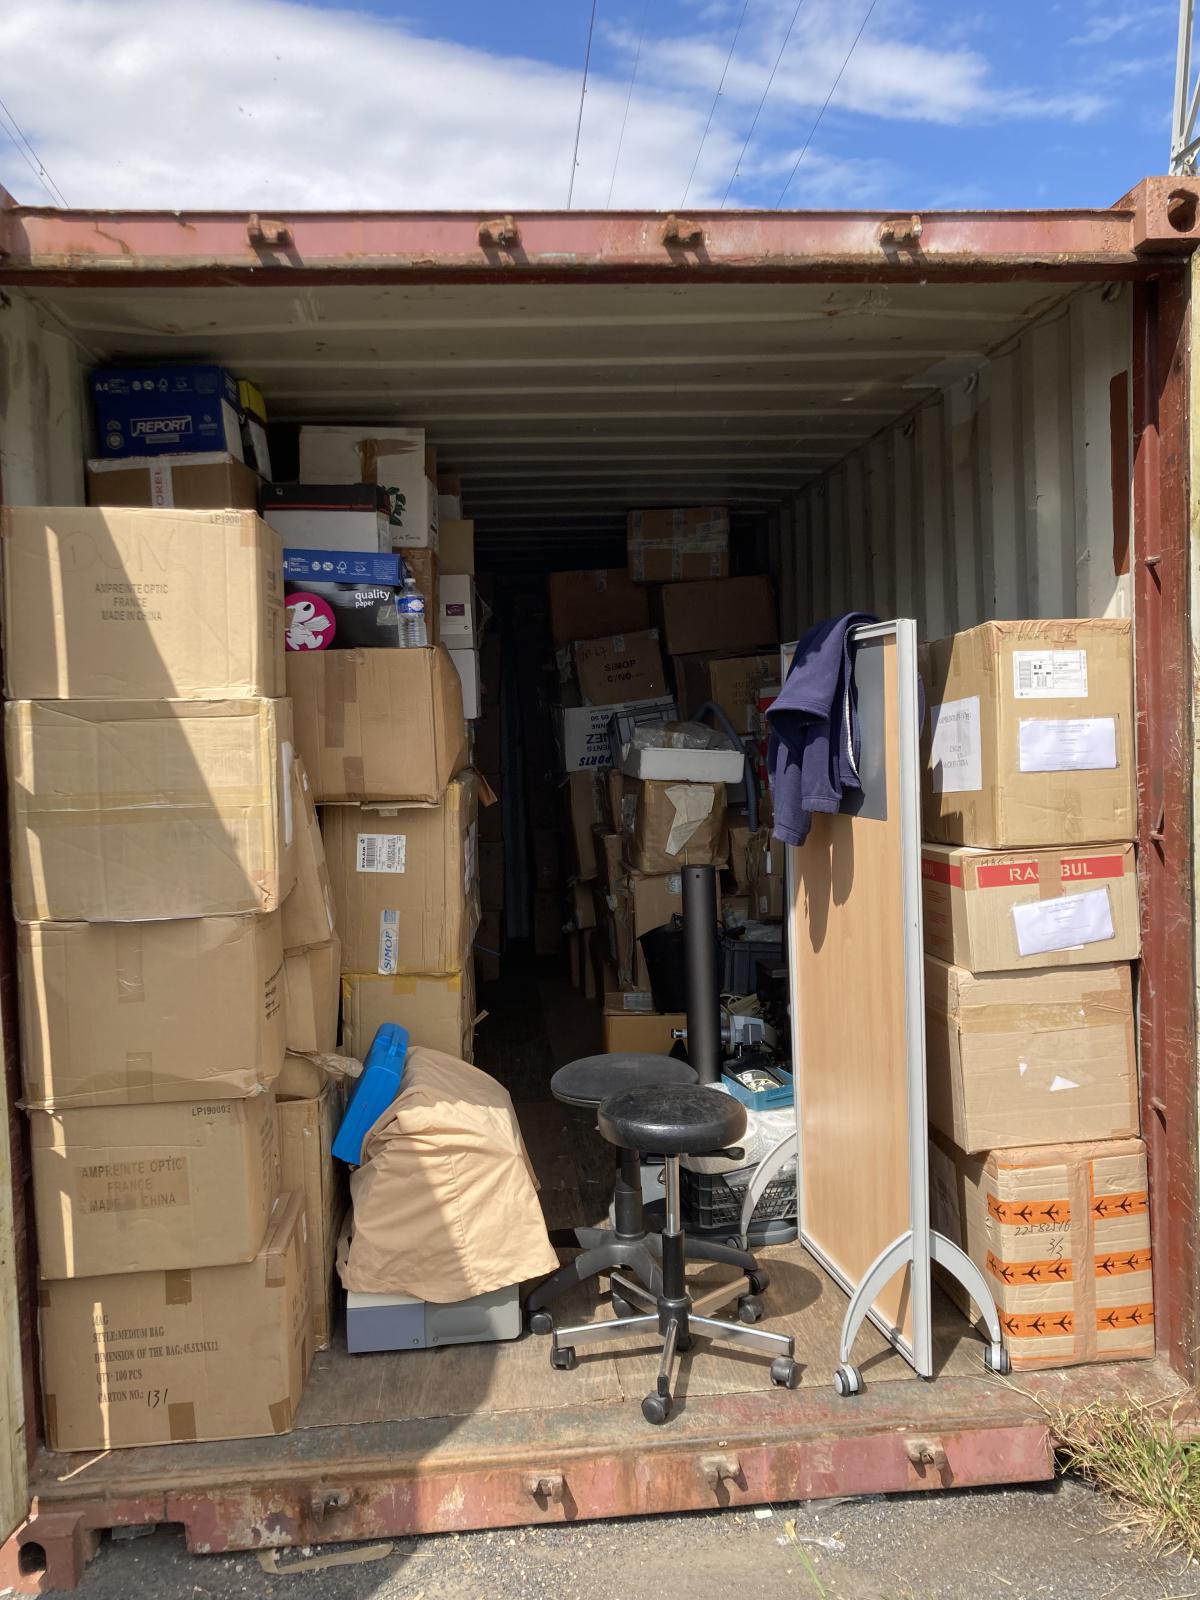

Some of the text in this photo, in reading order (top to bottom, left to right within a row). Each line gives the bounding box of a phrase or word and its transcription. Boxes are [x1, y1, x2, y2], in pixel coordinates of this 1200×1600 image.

[136, 418, 187, 434] REPORT
[143, 583, 170, 595] OPTIC
[354, 588, 391, 602] quality
[113, 597, 147, 607] FRANCE
[355, 600, 375, 609] paper
[101, 610, 126, 621] MADE
[384, 931, 393, 970] SIMOP
[81, 1157, 184, 1179] AMPREINTE OPTIC
[107, 1178, 152, 1194] FRANCE
[149, 1326, 165, 1338] BAG
[94, 1350, 135, 1364] DIMENSION
[136, 1350, 147, 1360] OF
[149, 1347, 163, 1358] THE
[115, 1369, 128, 1382] 100
[128, 1368, 143, 1381] PCS
[97, 1389, 128, 1404] CARTON
[147, 1388, 169, 1409] 131
